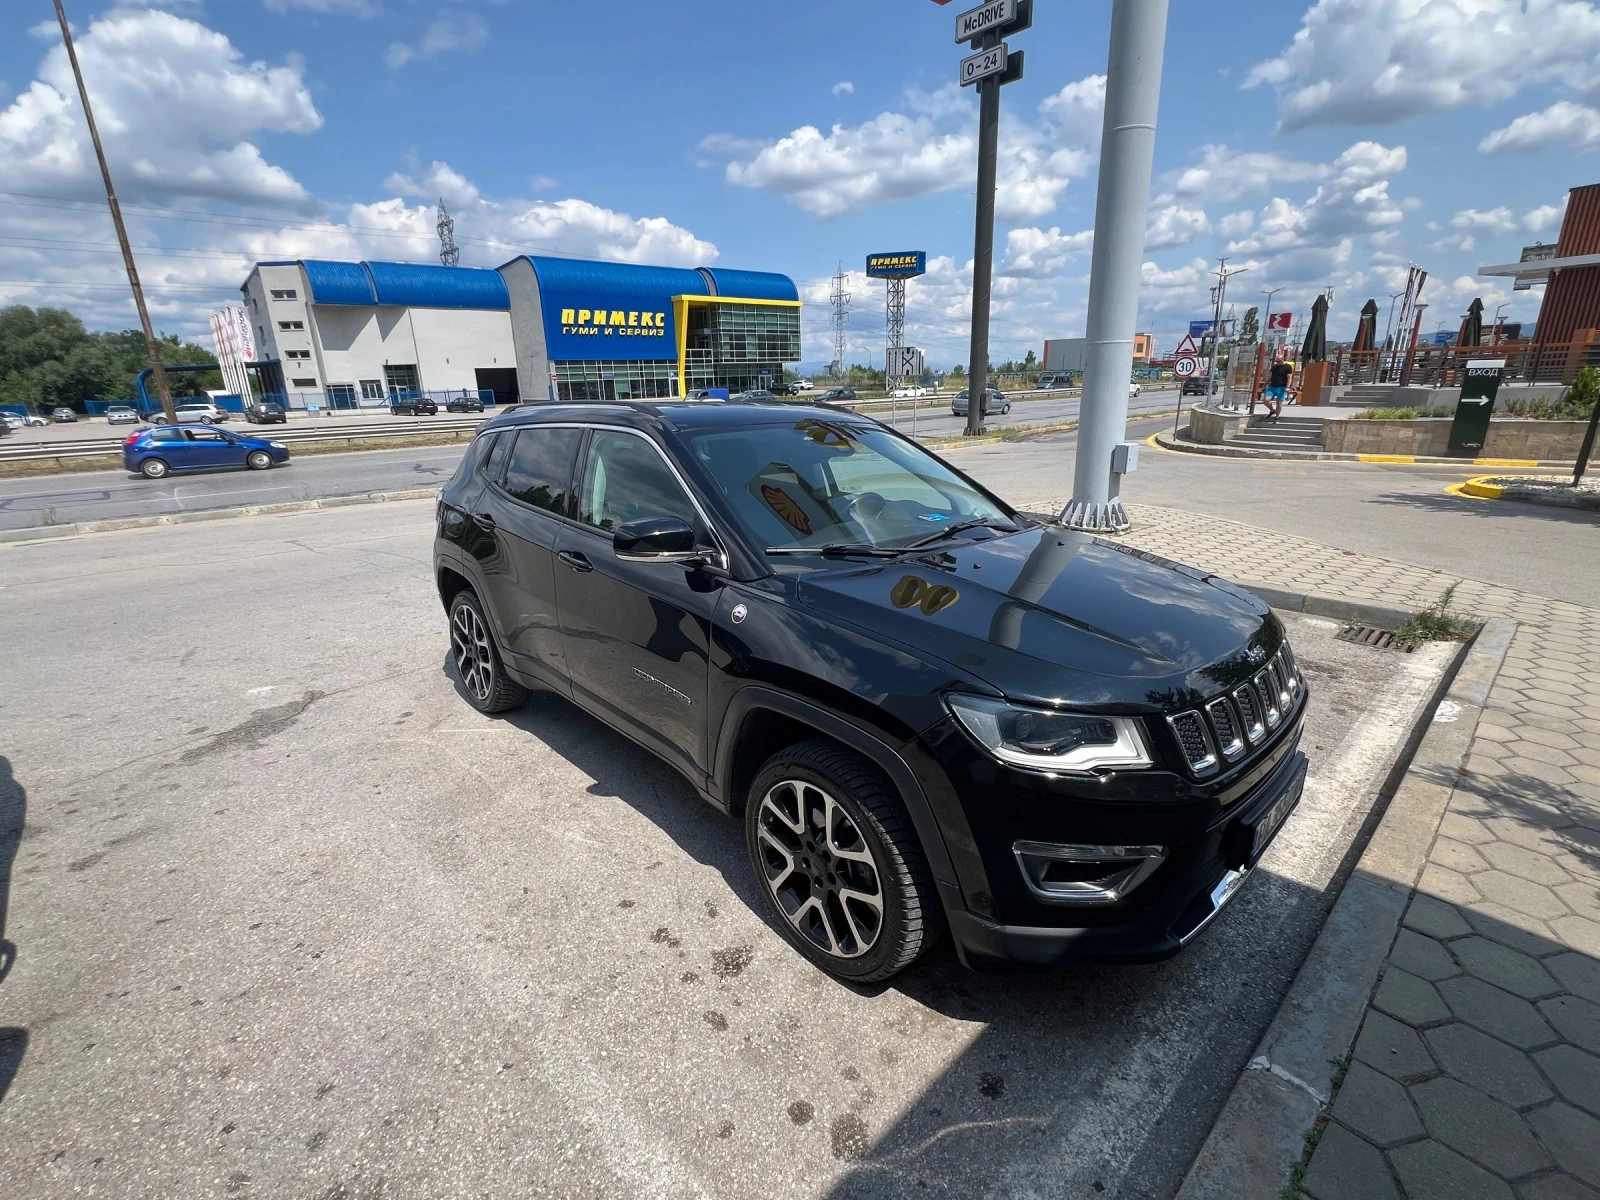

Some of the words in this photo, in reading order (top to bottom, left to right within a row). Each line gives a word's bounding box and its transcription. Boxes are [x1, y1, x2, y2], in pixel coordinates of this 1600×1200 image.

[963, 2, 1005, 33] McDRIVE
[870, 256, 917, 266] ПРИМЕКС
[561, 308, 665, 327] ПРИМЕКС
[562, 326, 598, 335] ГУМИ
[604, 327, 613, 335] И
[619, 328, 665, 336] СЕРВИЗ
[1178, 361, 1192, 373] 30
[1468, 368, 1499, 377] ВХОД
